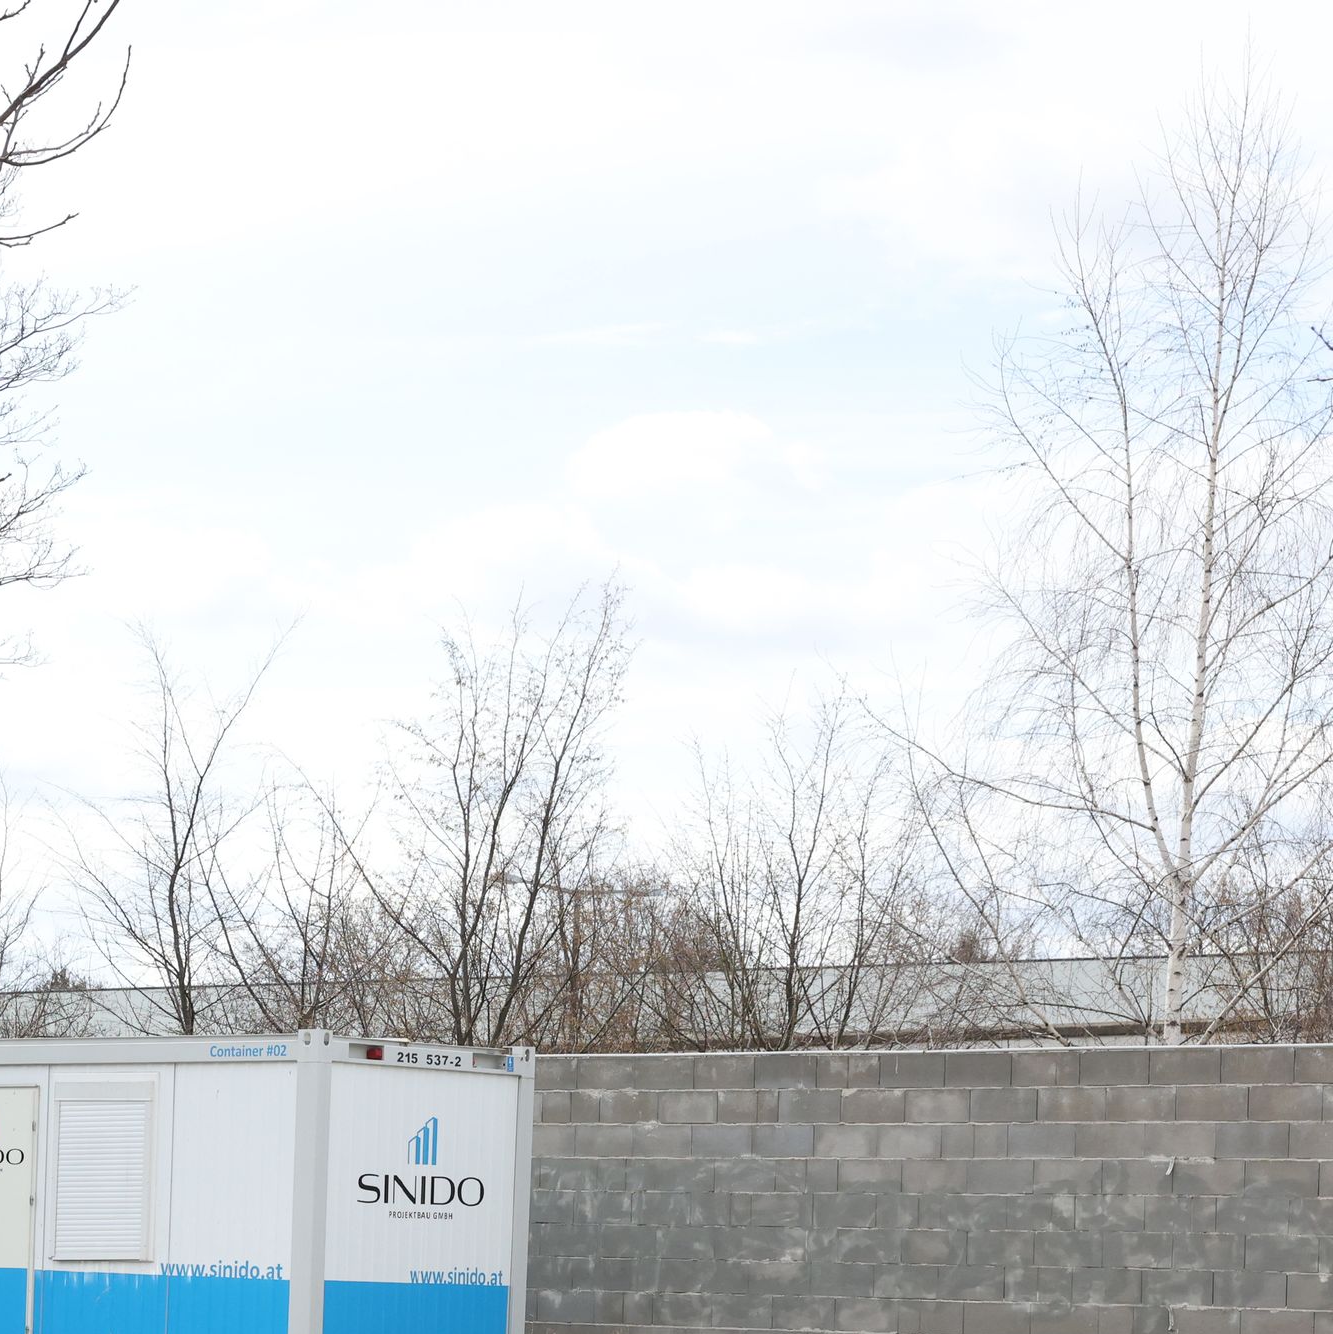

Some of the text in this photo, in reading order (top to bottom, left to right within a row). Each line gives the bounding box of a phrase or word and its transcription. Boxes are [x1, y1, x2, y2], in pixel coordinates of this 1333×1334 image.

[209, 1044, 287, 1058] Container #02
[396, 1052, 461, 1067] 215 537-2
[356, 1173, 485, 1207] SINIDO
[388, 1210, 453, 1220] PROJEKTBAU GMBH
[160, 1260, 283, 1281] www.sinido.at
[409, 1267, 503, 1286] www.sinido.at
